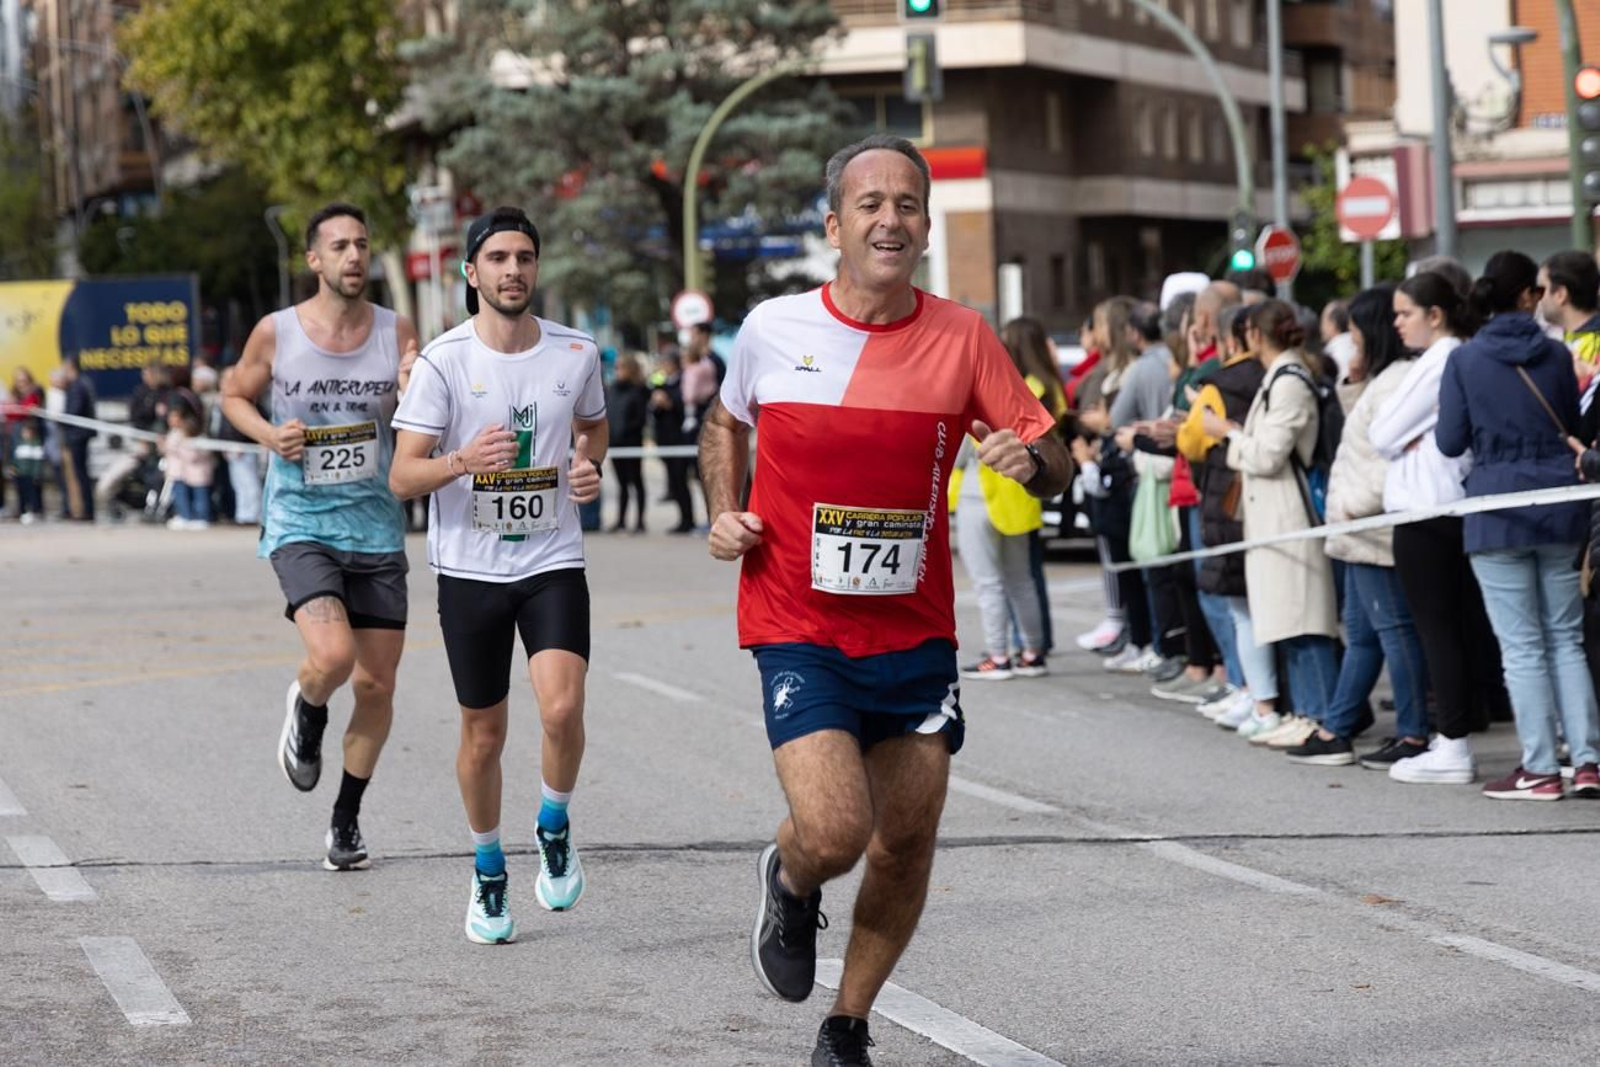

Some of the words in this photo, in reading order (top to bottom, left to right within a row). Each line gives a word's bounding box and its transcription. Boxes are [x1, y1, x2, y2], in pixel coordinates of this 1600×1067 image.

[125, 301, 187, 323] TODO
[111, 325, 140, 346] LO
[144, 323, 188, 344] QUE
[285, 381, 300, 396] LA
[309, 402, 331, 413] RUN
[935, 421, 947, 459] CLUB
[319, 446, 366, 470] 225
[475, 473, 496, 485] XXV
[492, 494, 544, 520] 160
[925, 461, 941, 531] ATLETISMO
[819, 508, 845, 526] XXV
[846, 511, 885, 521] CARRERA
[887, 513, 923, 522] POPULAR
[856, 520, 879, 529] gran
[837, 542, 901, 575] 174
